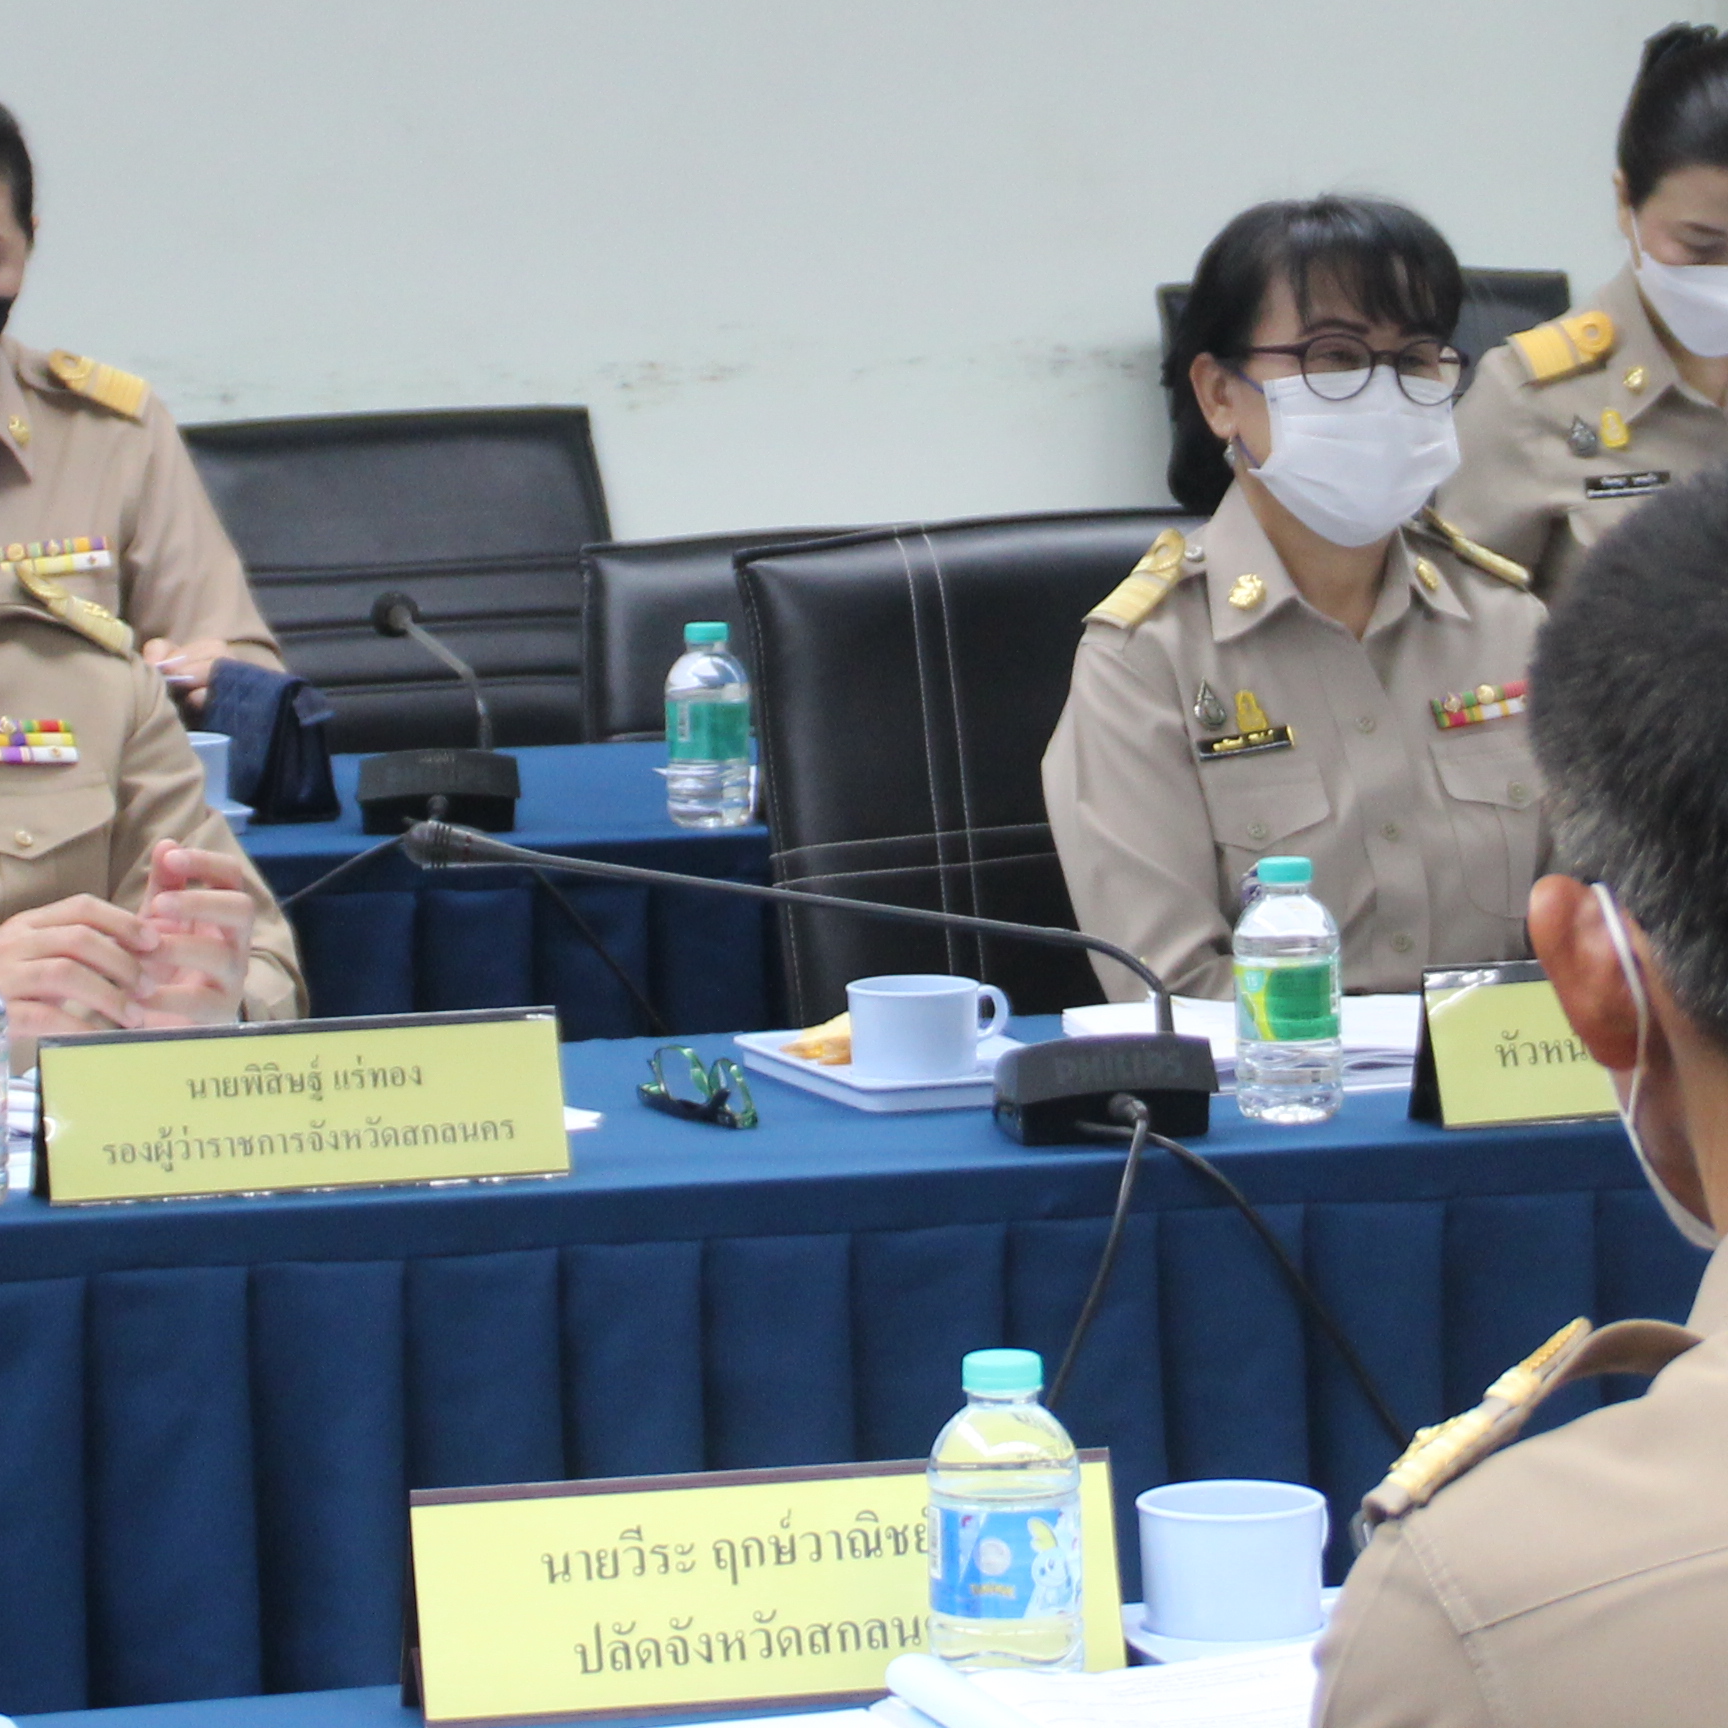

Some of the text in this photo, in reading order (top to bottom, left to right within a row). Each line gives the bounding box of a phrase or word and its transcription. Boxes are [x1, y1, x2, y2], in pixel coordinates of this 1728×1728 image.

[1495, 1028, 1589, 1068] หัวหน
[185, 1054, 423, 1103] นายพิสิษฐ์ แร่ทอง
[101, 1115, 517, 1173] รองผู้ว่าราชการจังหวัดสกลนคร
[541, 1524, 697, 1586] นายวีระ
[573, 1608, 930, 1676] ปลัดจังหวัดสกลน
